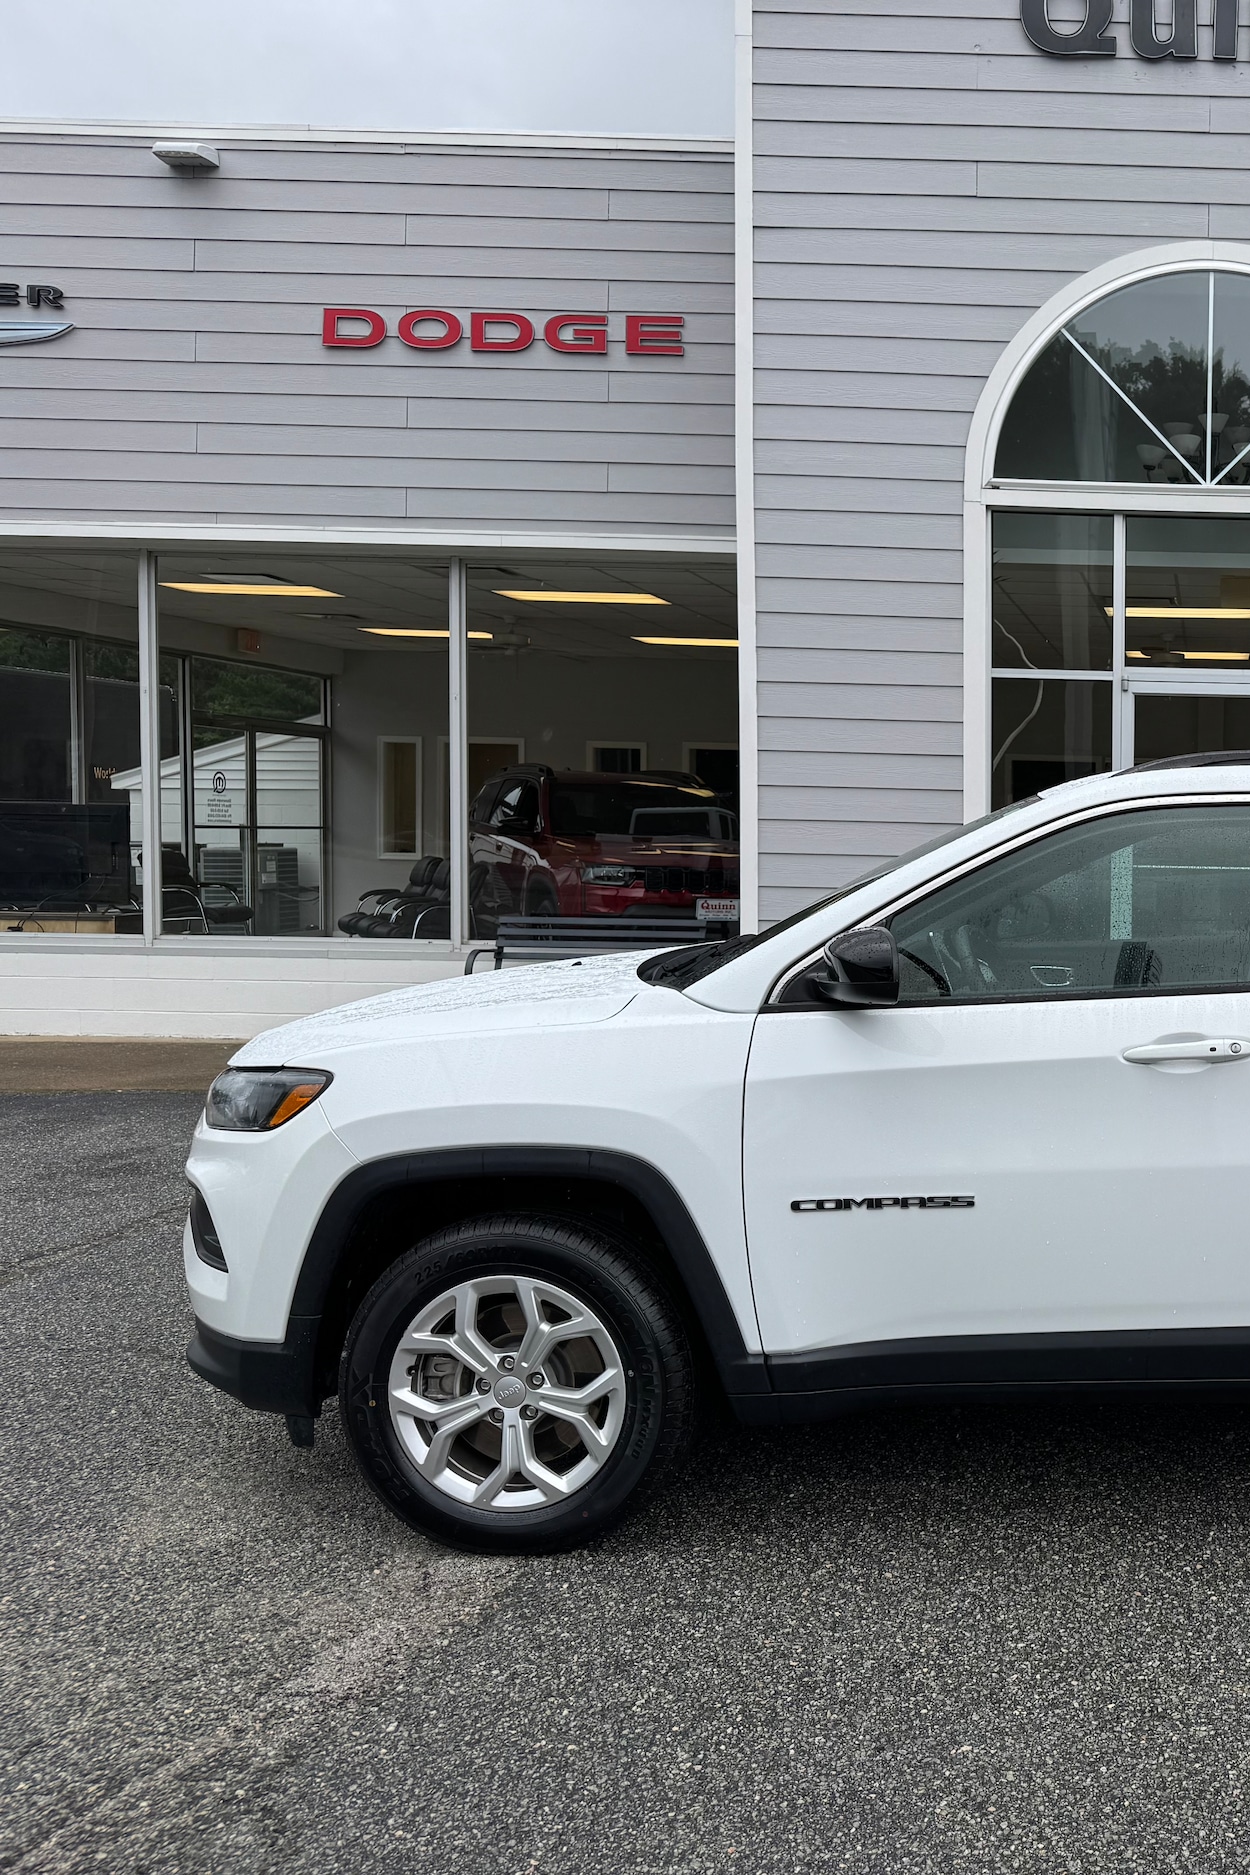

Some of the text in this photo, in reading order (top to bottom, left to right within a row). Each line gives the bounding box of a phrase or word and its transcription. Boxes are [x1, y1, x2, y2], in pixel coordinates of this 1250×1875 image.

[322, 307, 684, 355] DODGE
[701, 901, 736, 911] Quinn
[790, 1195, 975, 1213] COMPASS
[498, 1384, 521, 1400] Jeep
